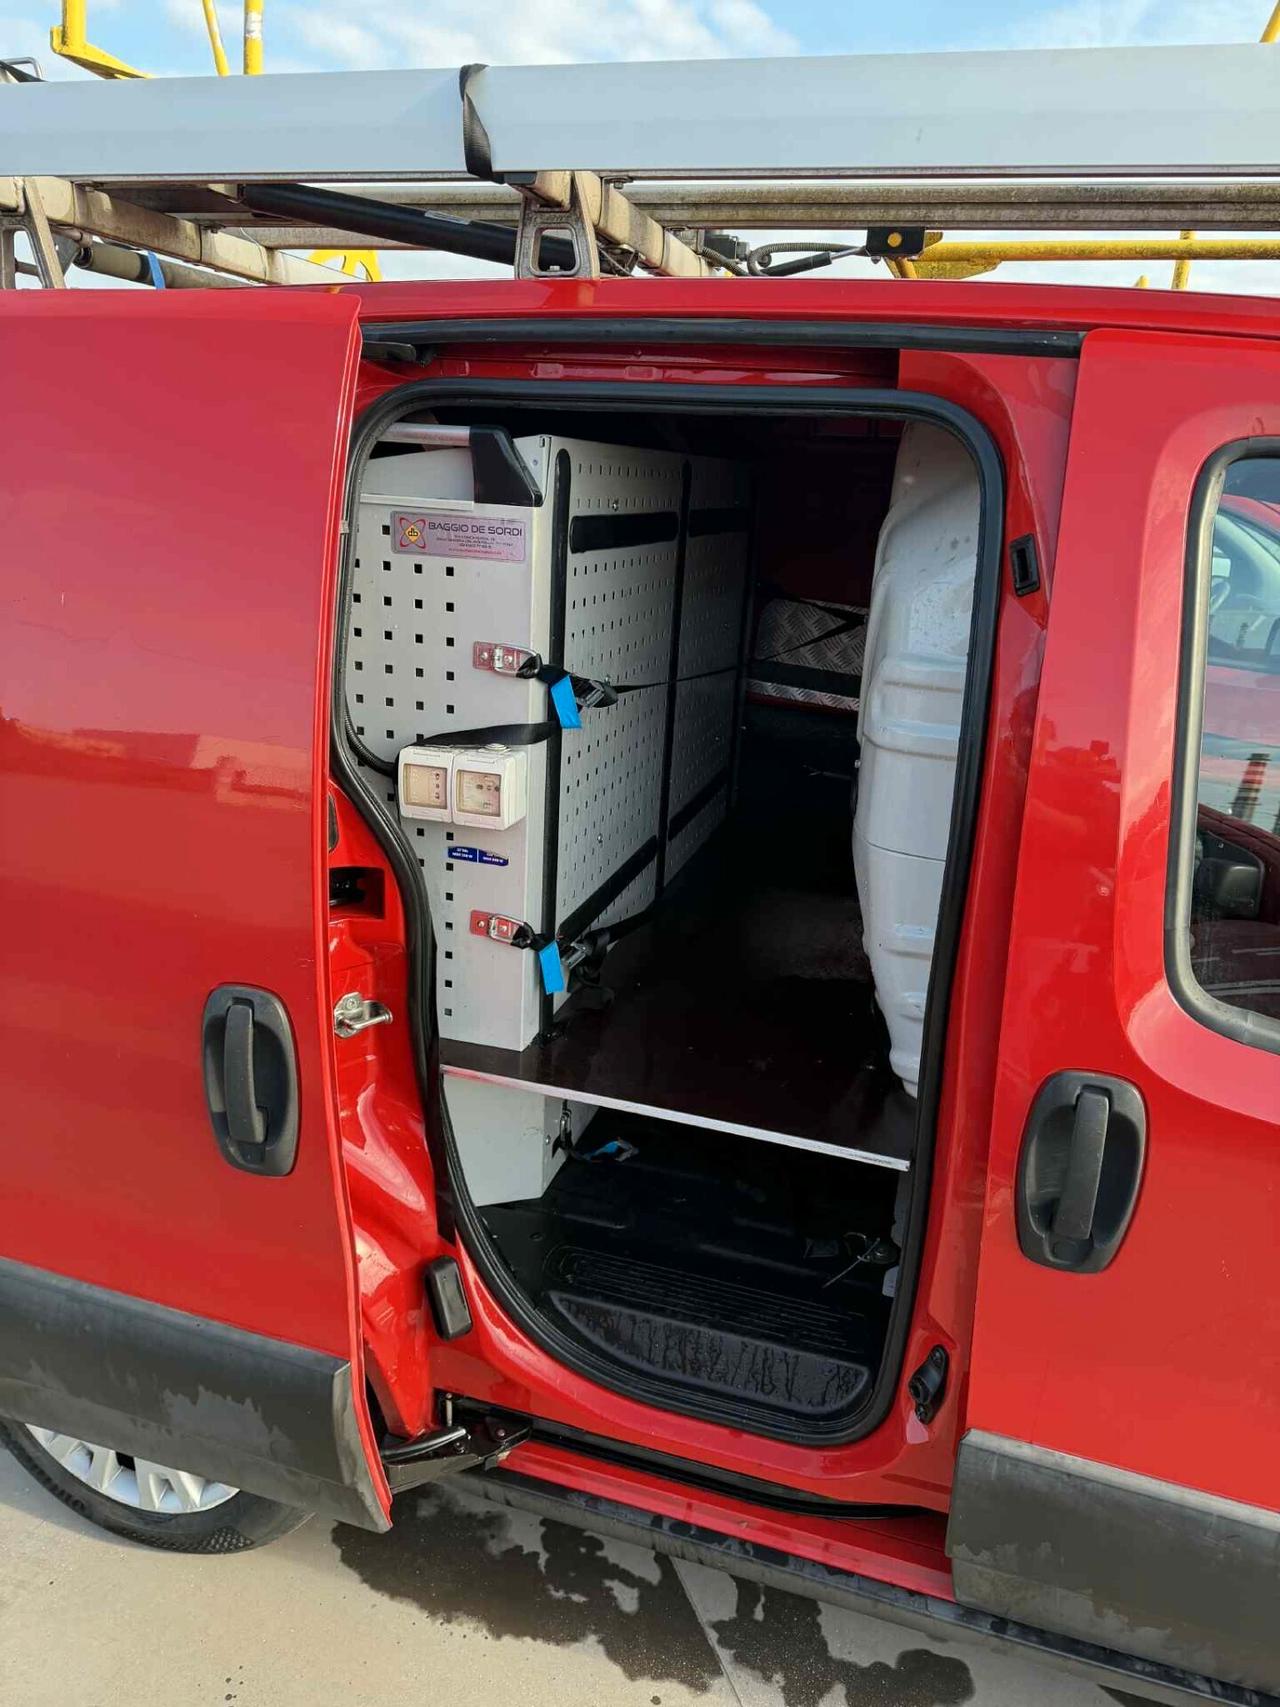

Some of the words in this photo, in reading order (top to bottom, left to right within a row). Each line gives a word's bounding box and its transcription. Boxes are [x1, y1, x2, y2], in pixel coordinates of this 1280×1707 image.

[428, 522, 469, 532] BAGGIO
[471, 525, 485, 533] DE
[488, 526, 522, 536] SORDI
